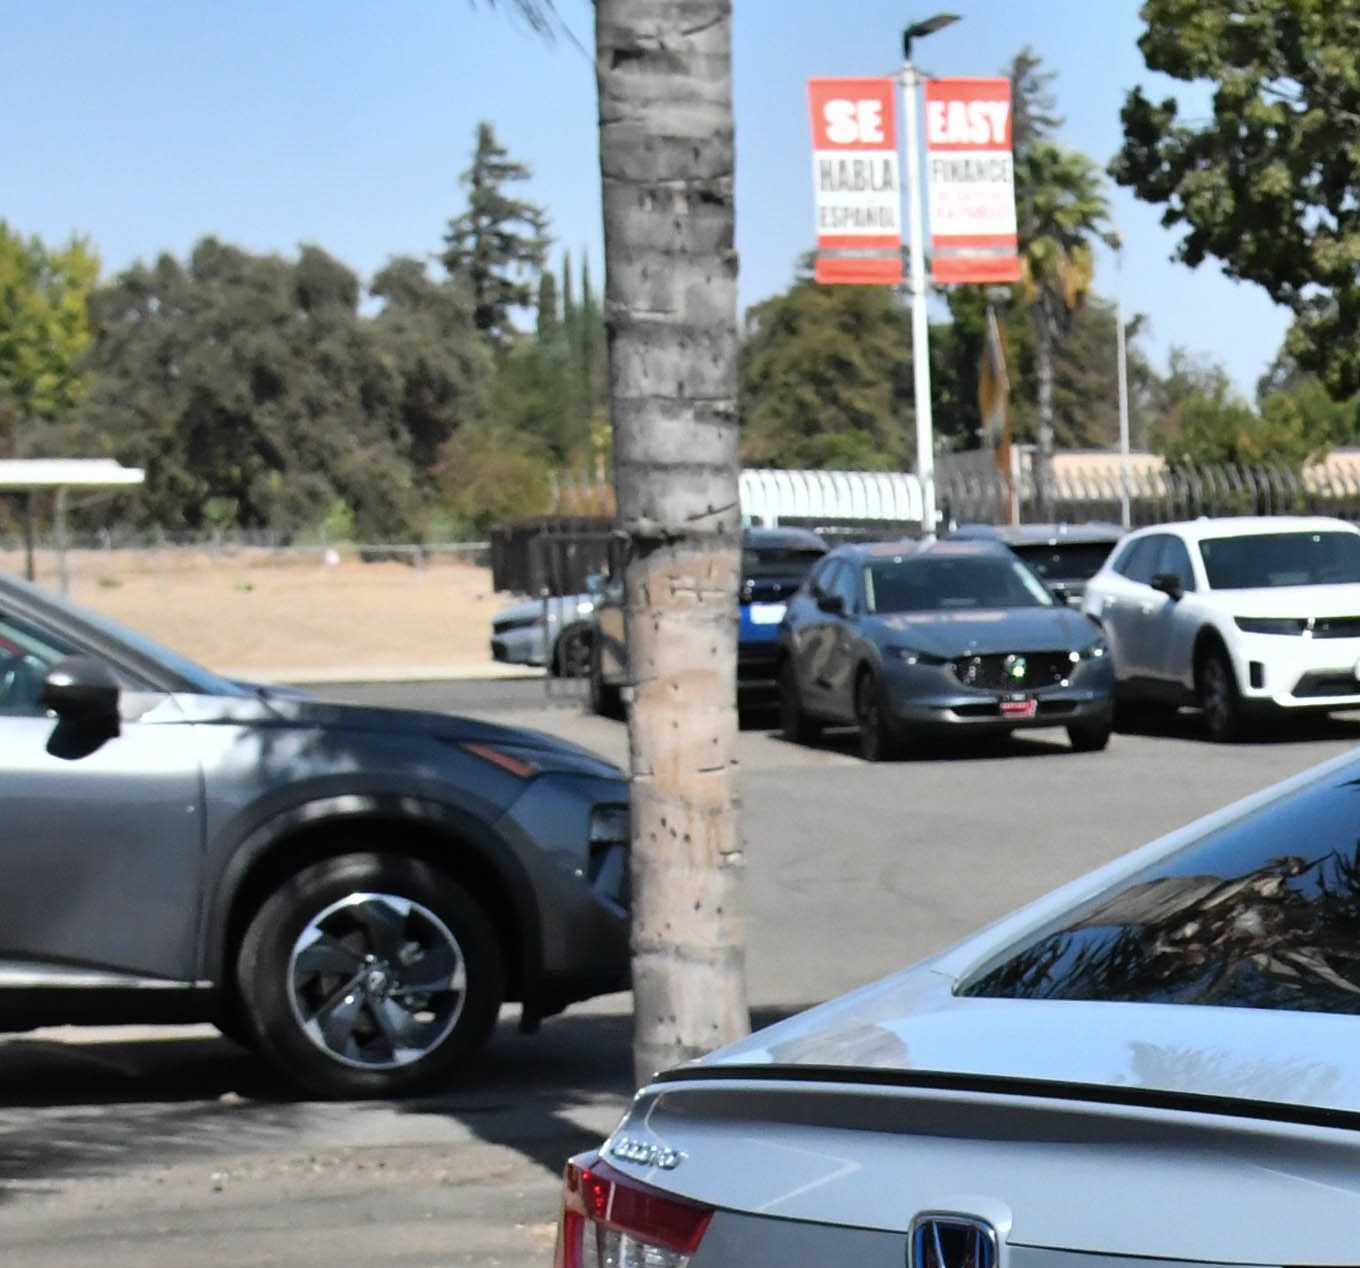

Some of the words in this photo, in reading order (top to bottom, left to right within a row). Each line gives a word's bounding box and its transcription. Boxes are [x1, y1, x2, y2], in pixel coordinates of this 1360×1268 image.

[822, 98, 885, 145] SE
[927, 99, 1010, 145] EASY
[818, 158, 895, 193] HABLA
